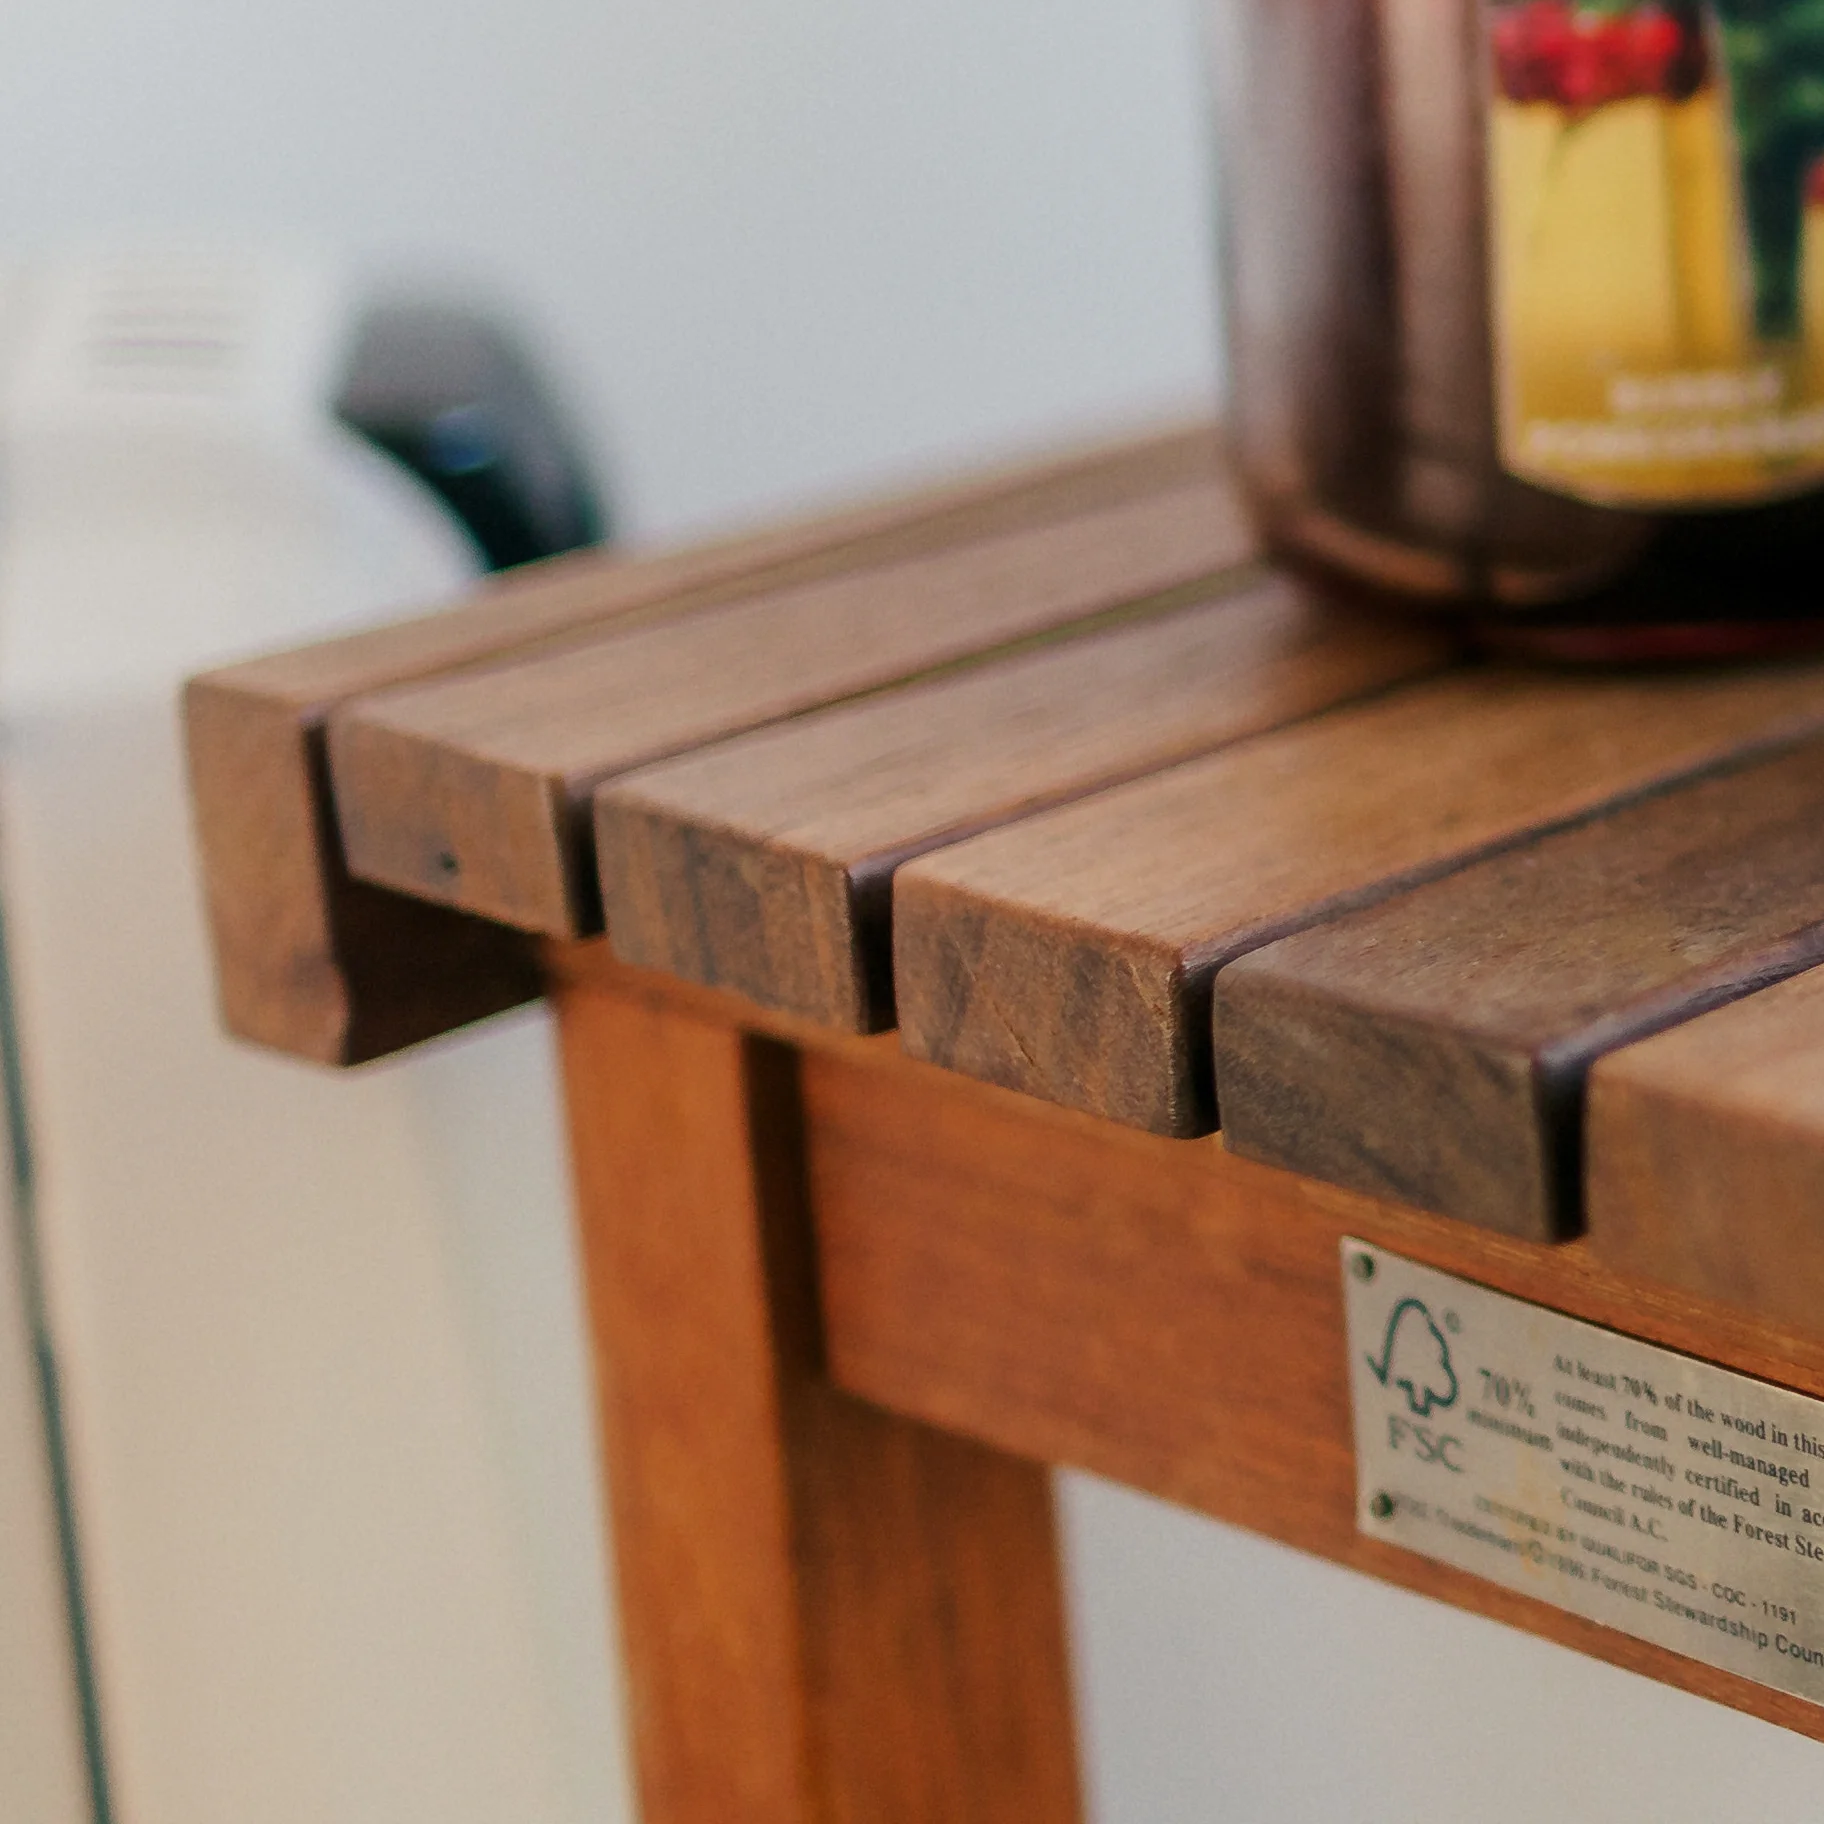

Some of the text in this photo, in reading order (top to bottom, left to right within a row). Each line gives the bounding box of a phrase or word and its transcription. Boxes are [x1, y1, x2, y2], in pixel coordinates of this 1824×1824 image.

[1387, 1414, 1464, 1474] FSC
[1664, 1391, 1683, 1412] of
[1687, 1398, 1714, 1423] the
[1720, 1410, 1766, 1441] wood
[1771, 1424, 1788, 1447] in
[1687, 1435, 1810, 1489] well-managed
[1685, 1465, 1760, 1507] certified
[1775, 1493, 1792, 1518] in
[1678, 1498, 1696, 1518] of
[1700, 1504, 1728, 1528] the
[1733, 1513, 1791, 1551] Forest
[1653, 1587, 1768, 1650] Stewardship
[1762, 1599, 1798, 1626] 1191
